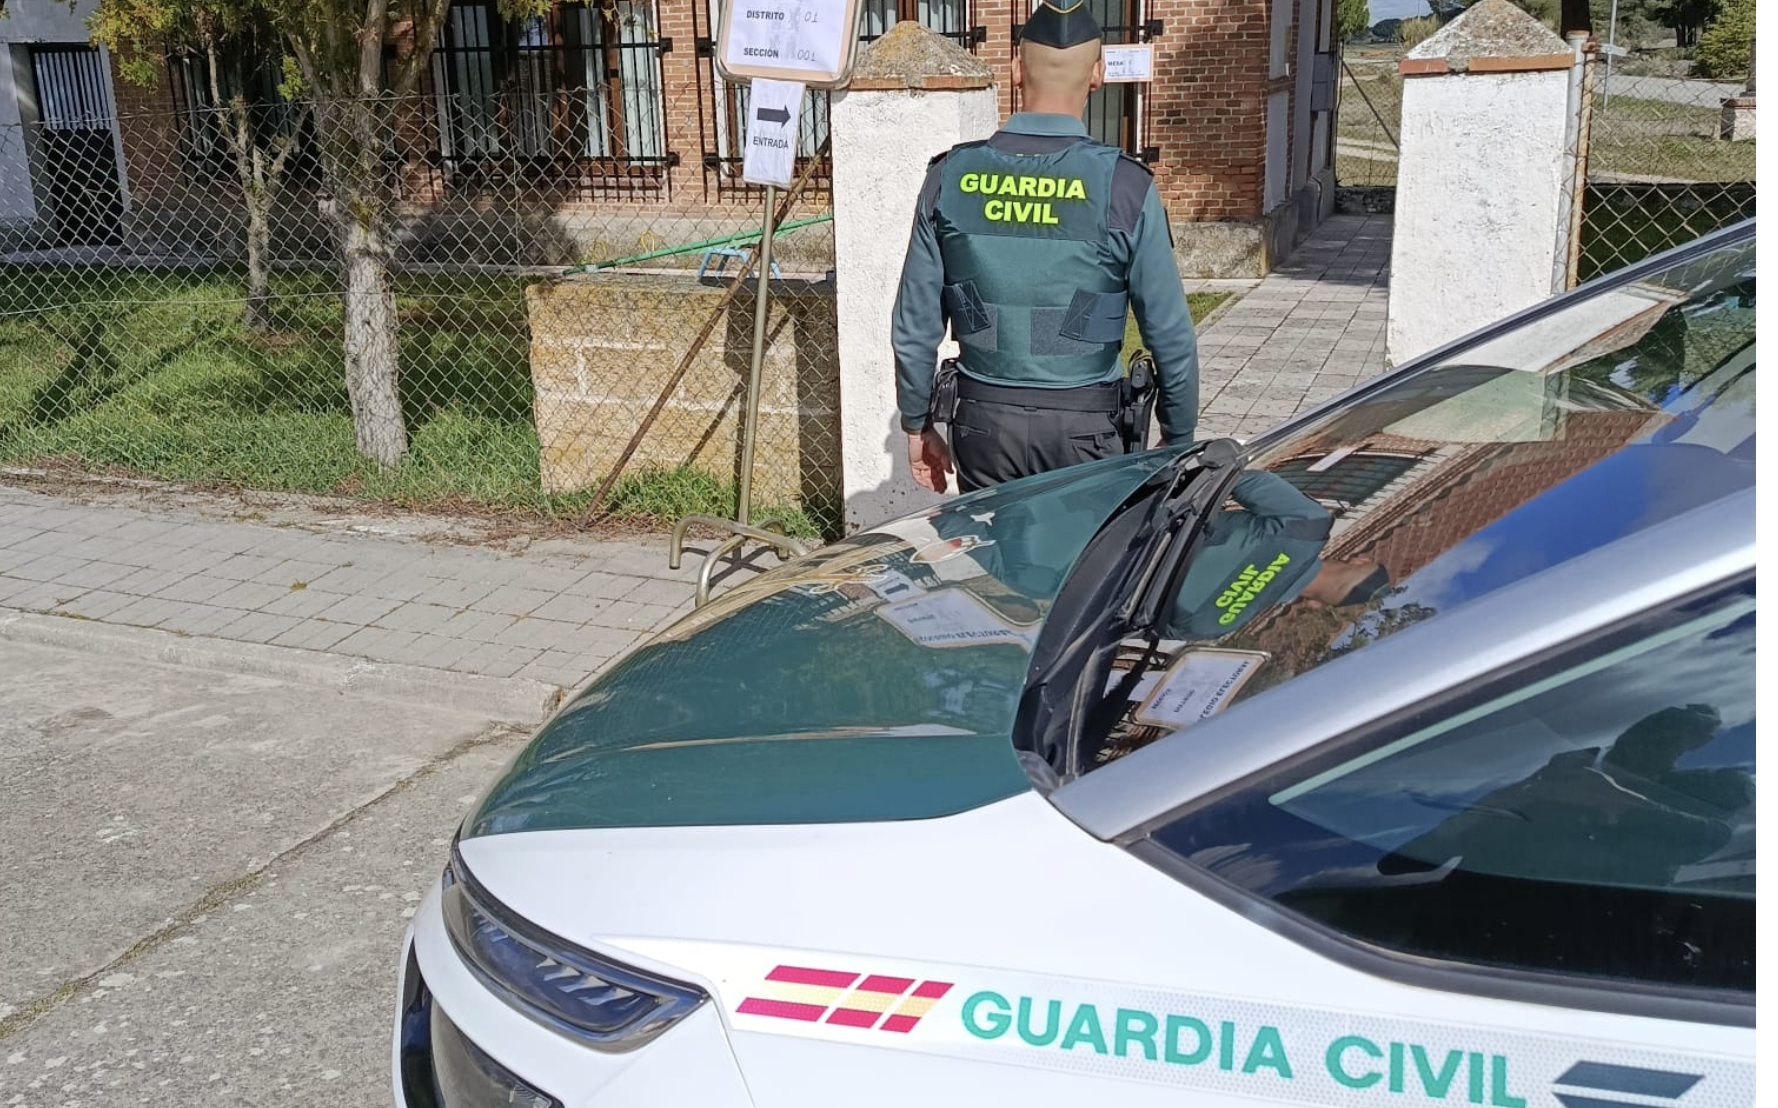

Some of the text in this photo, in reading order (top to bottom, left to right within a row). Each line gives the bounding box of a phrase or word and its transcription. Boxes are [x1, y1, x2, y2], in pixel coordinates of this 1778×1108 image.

[746, 10, 819, 23] DISTRITO 01
[797, 49, 817, 62] 001
[752, 135, 789, 149] ENTRADA
[960, 173, 1086, 200] GUARDIA
[984, 199, 1059, 224] CIVIL
[960, 990, 1527, 1108] GUARDIA CIVIL
